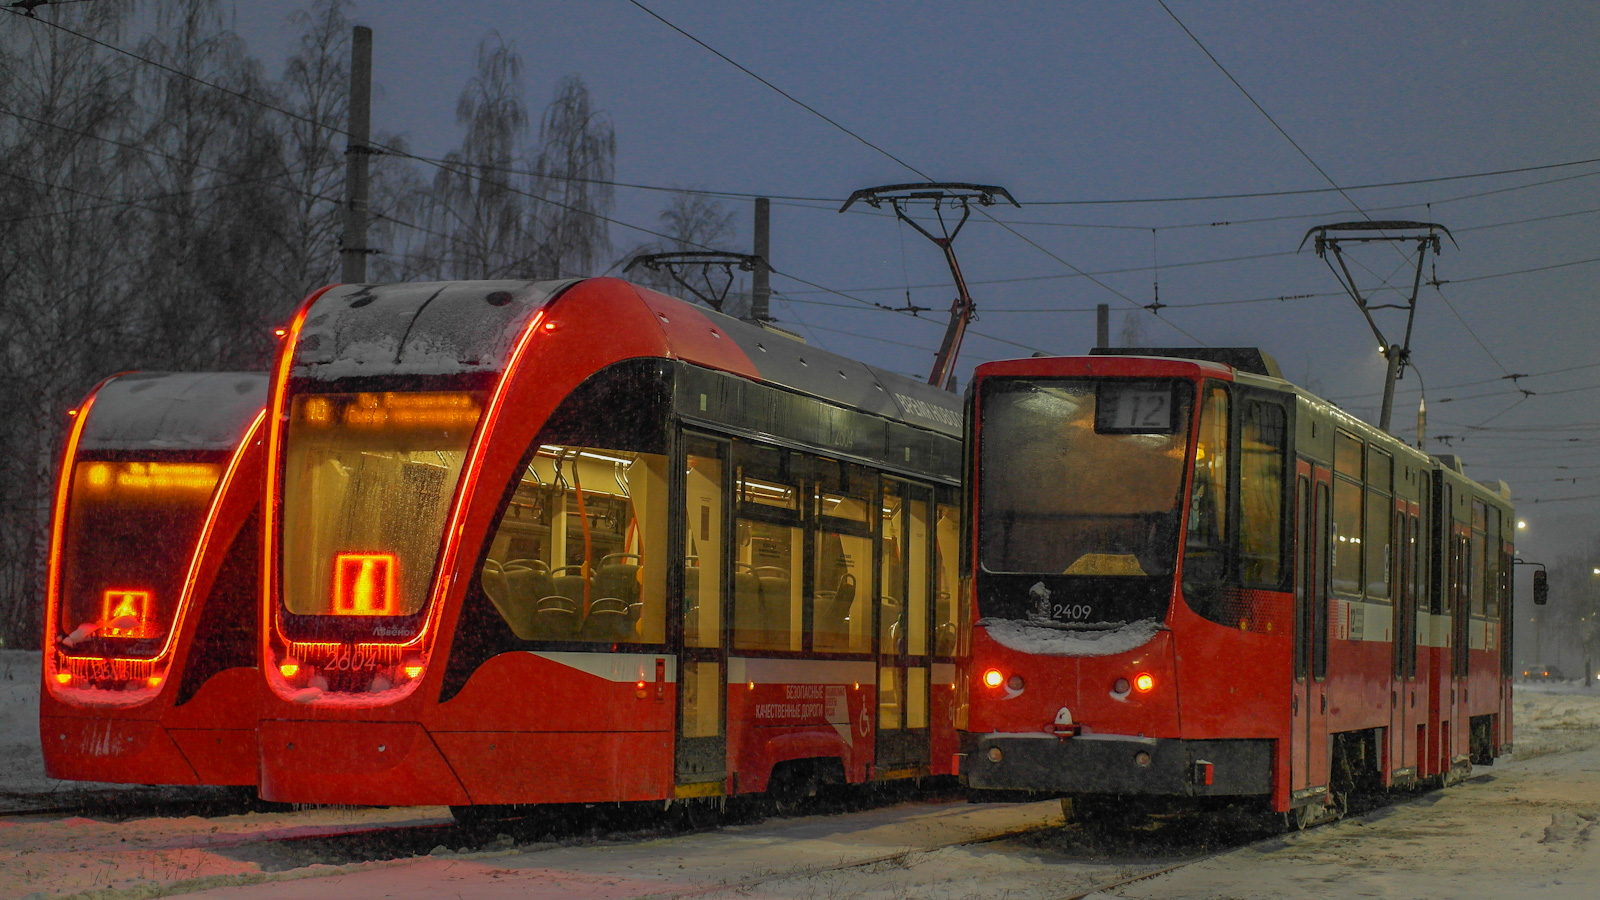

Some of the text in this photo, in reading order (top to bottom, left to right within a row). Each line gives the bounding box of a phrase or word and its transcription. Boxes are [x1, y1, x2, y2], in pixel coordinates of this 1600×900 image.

[1131, 396, 1165, 426] 12
[1052, 603, 1092, 620] 2409
[324, 650, 377, 671] 2604
[786, 685, 824, 699] БЕЗОПАСНЫЕ
[756, 704, 801, 719] КАЧЕСТВЕННЫЕ
[800, 703, 824, 720] ДОРОГИ
